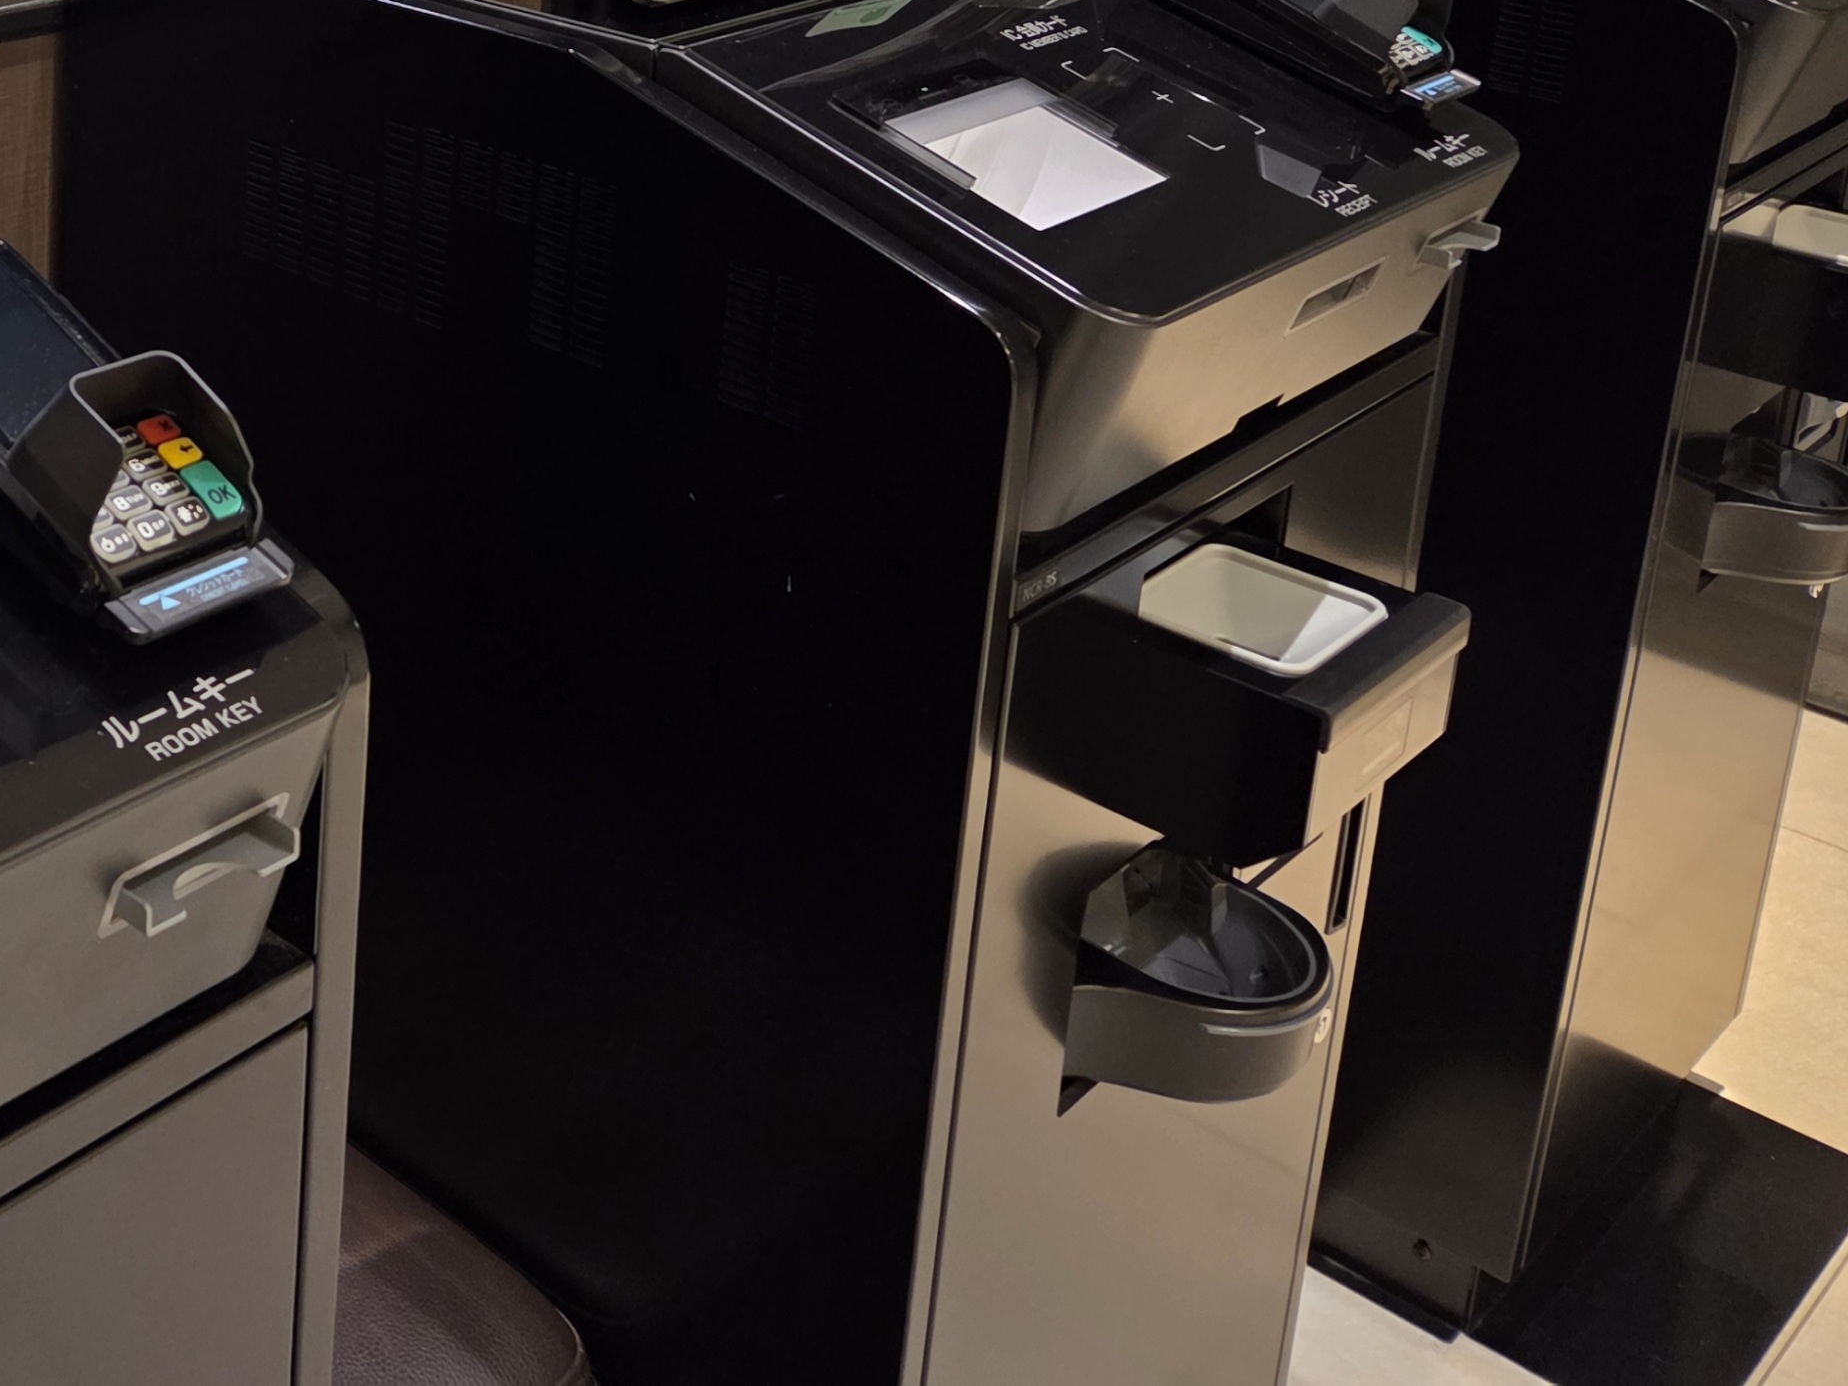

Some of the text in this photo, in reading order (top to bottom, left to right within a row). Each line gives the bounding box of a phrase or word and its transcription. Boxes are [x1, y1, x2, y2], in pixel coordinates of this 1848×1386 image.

[1000, 15, 1067, 41] IC 会員カード
[1413, 134, 1470, 161] ルームキー
[1442, 145, 1488, 168] ROOM KEY
[1307, 181, 1360, 208] レシート
[1335, 194, 1378, 217] RECEIPT
[129, 458, 145, 472] 6
[113, 496, 129, 511] 8
[208, 485, 236, 505] OK
[101, 667, 255, 749] ルームキー
[144, 696, 263, 762] ROOM KEY
